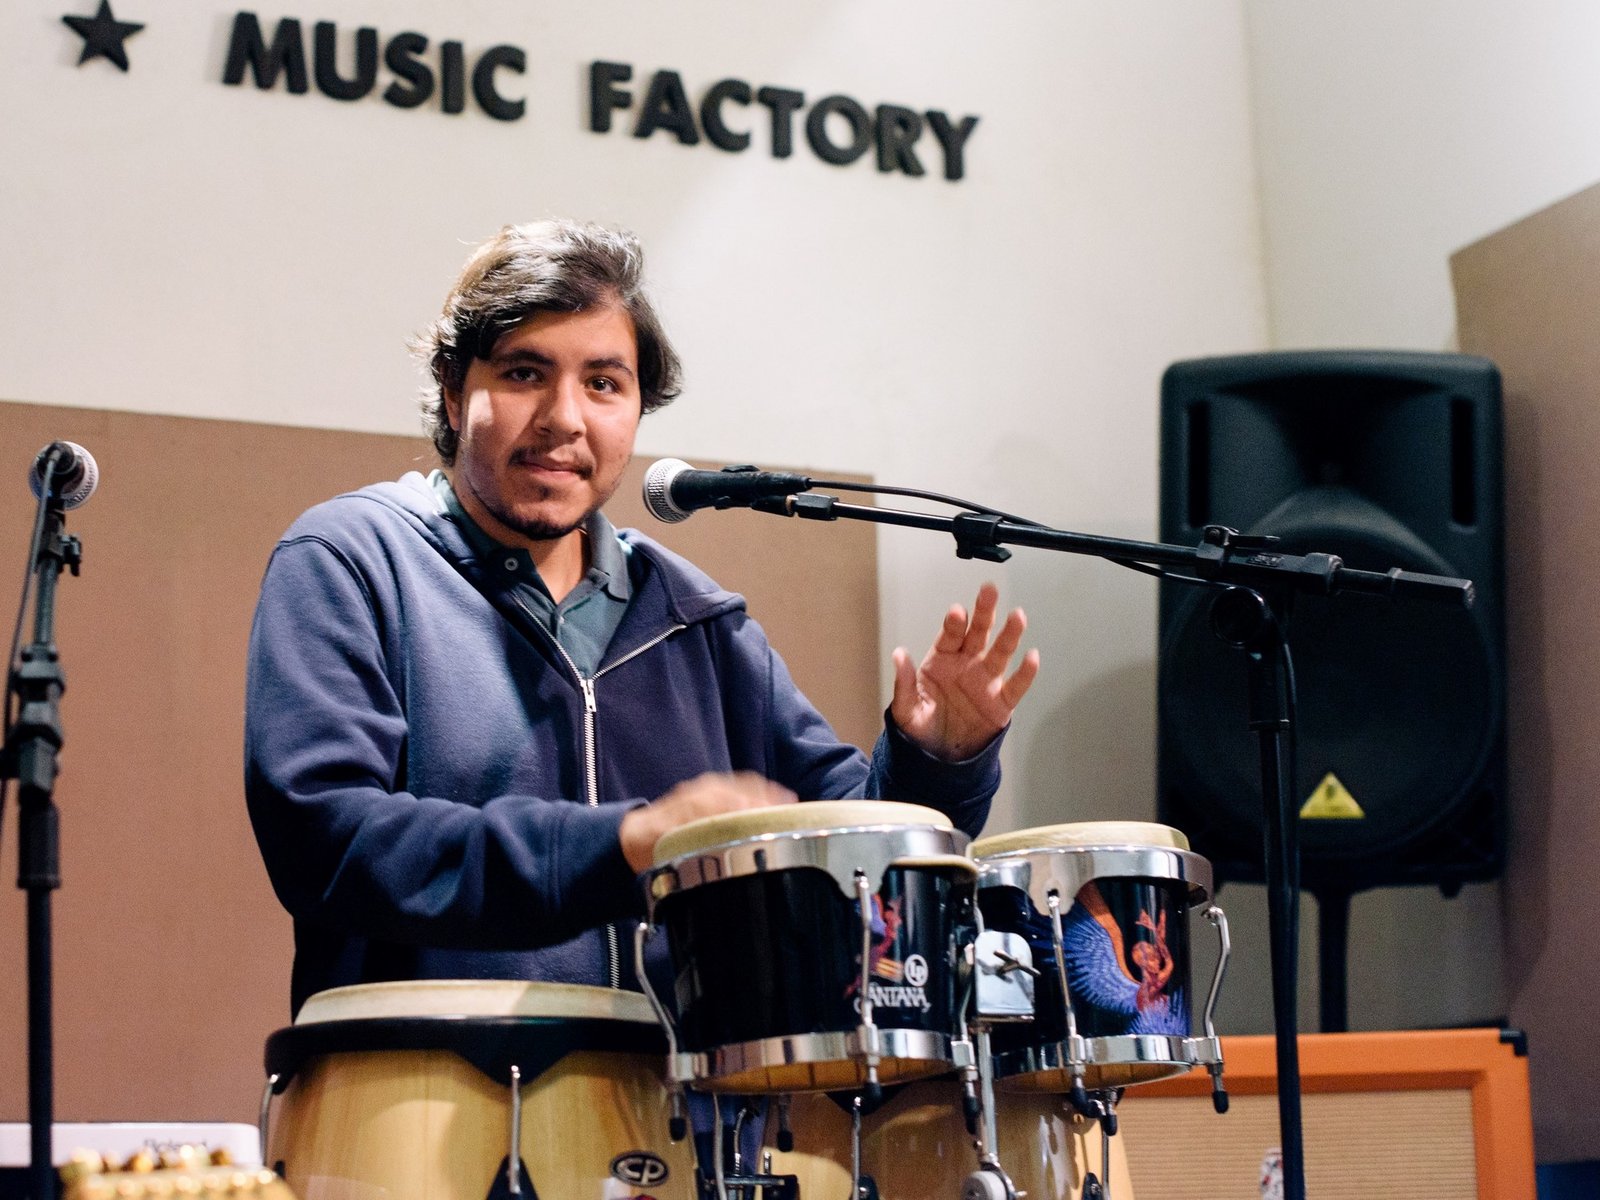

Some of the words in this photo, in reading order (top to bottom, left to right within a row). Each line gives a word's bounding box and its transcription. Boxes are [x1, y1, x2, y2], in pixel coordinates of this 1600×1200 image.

[222, 11, 527, 122] MUSIC
[588, 60, 979, 182] FACTORY
[616, 1158, 665, 1185] CP
